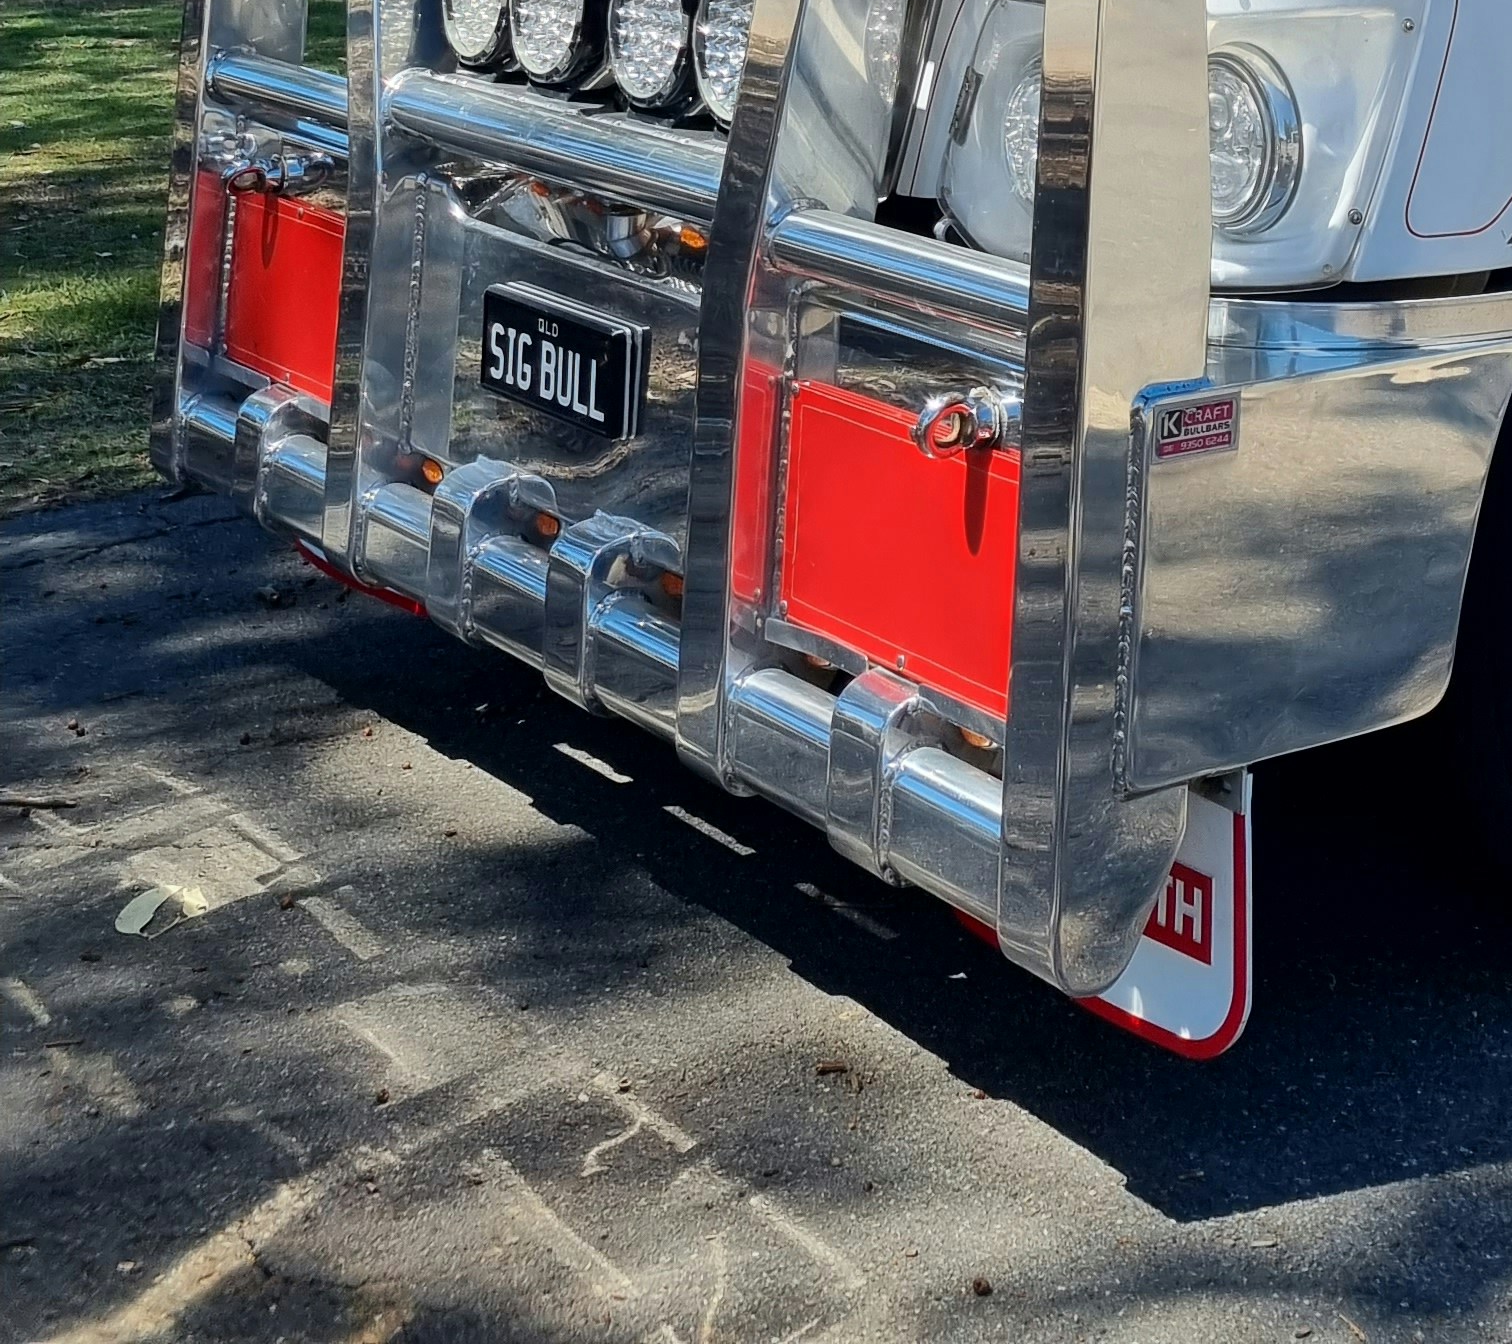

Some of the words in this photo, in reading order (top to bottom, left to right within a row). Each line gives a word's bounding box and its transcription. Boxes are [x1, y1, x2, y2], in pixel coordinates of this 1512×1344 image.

[537, 317, 560, 339] QLD
[488, 321, 534, 392] SIG
[538, 338, 606, 424] BULL
[1162, 411, 1181, 437] K
[1184, 404, 1231, 424] CRAFT
[1183, 421, 1231, 437] BULLBARS
[1180, 438, 1204, 451] 9350
